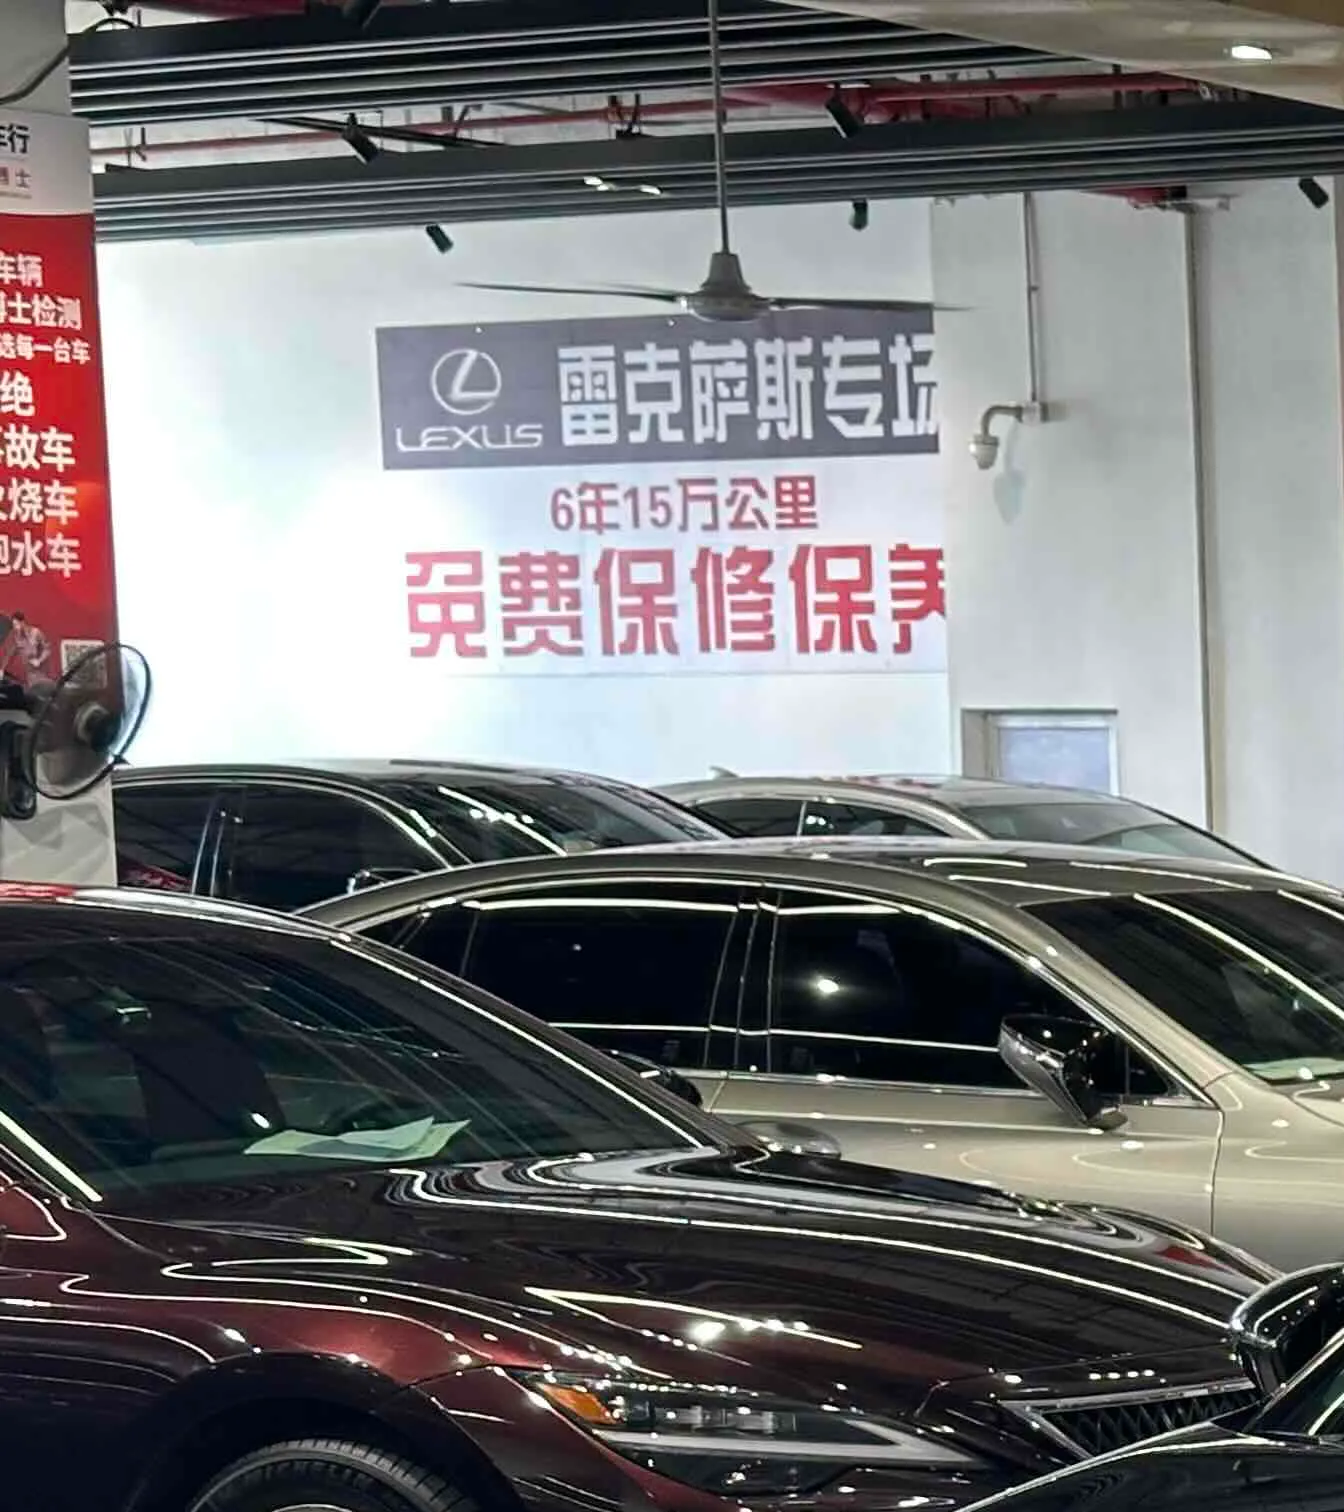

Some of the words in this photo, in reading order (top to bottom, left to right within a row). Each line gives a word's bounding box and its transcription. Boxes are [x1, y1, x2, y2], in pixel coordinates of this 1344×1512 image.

[0, 289, 82, 330] 士检测
[557, 333, 940, 446] 雷克萨斯专场
[0, 423, 76, 473] 故车
[395, 422, 543, 452] LEXUS
[550, 475, 819, 534] 6年15万公里
